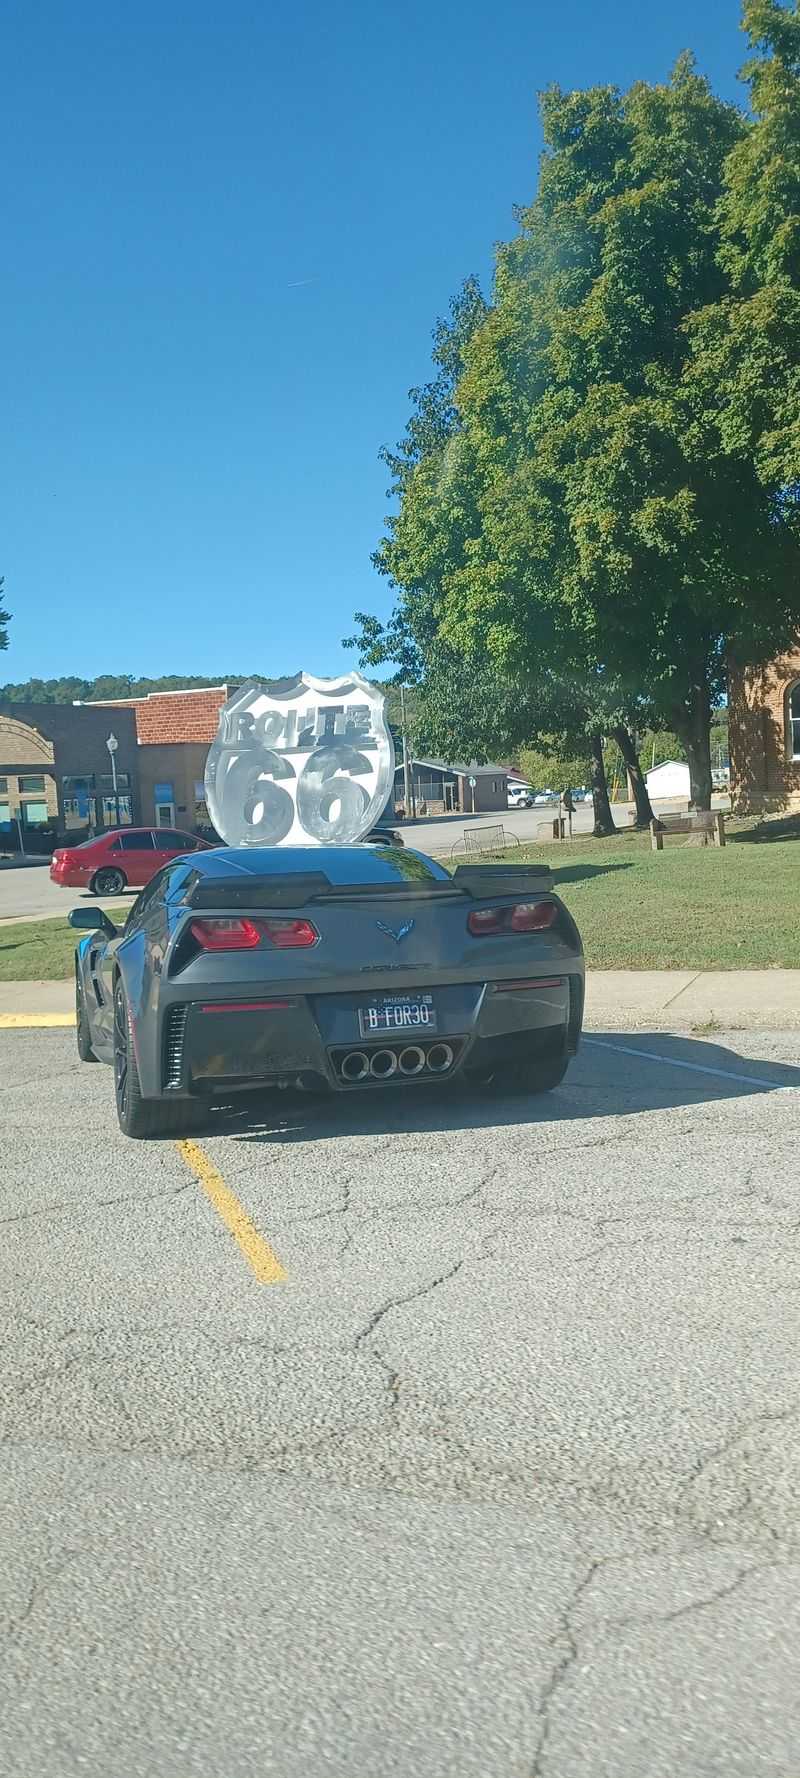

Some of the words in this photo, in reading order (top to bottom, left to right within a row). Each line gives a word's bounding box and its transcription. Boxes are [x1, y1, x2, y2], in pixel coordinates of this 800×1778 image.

[225, 704, 375, 746] ROUTE
[219, 748, 374, 842] 66
[368, 1008, 378, 1028] B
